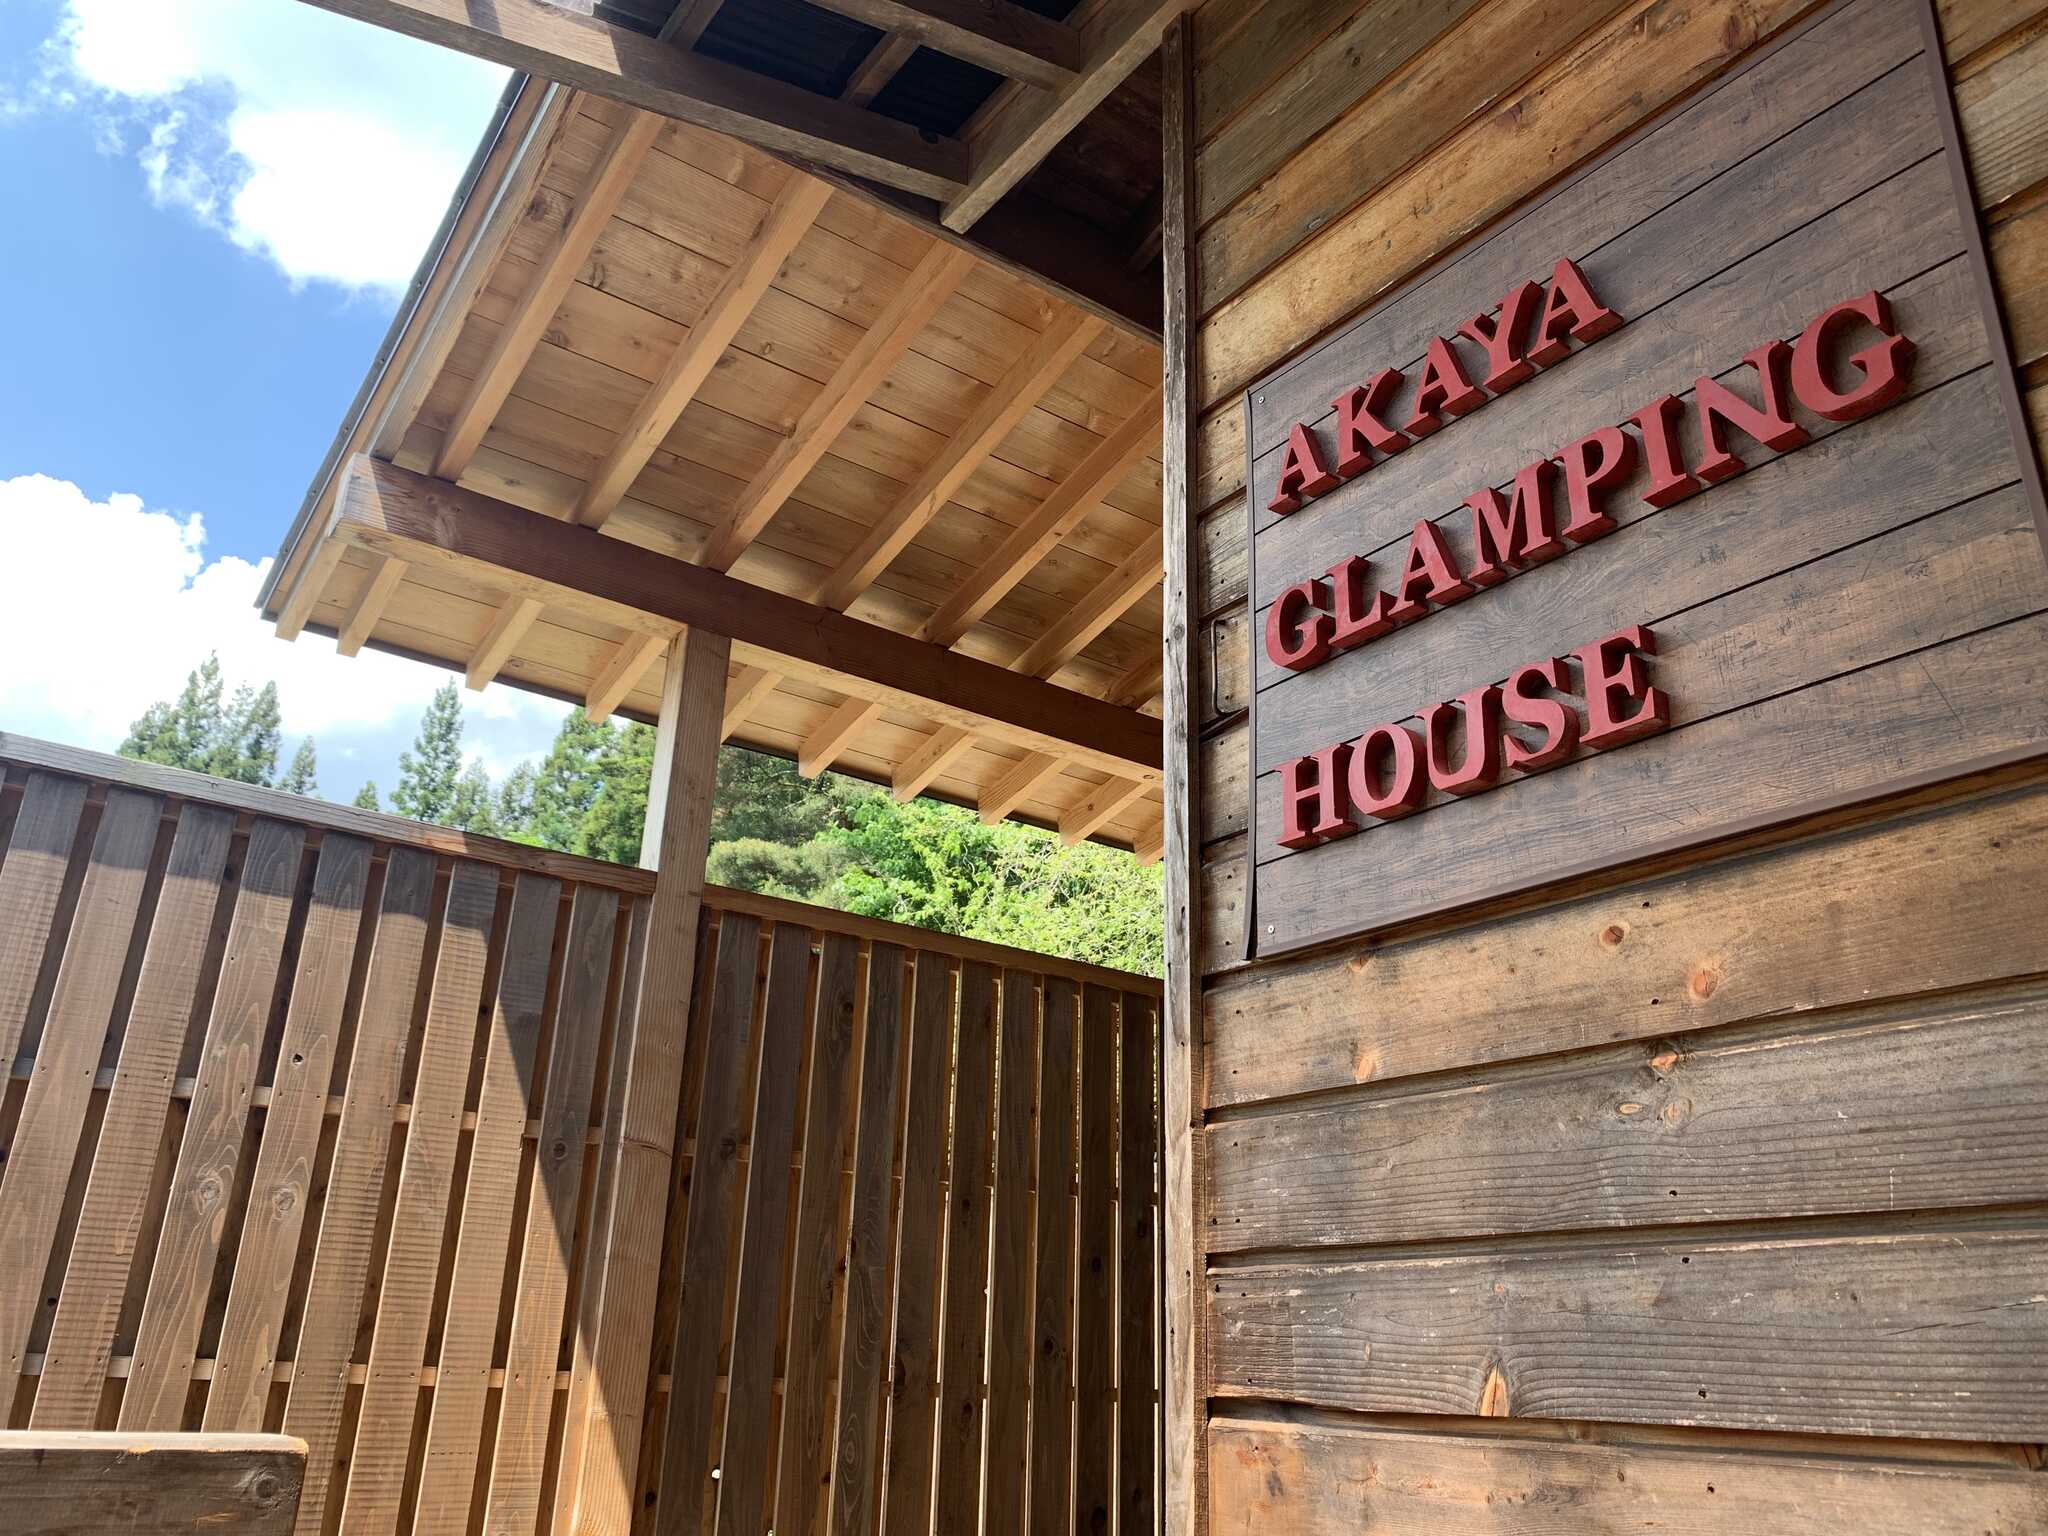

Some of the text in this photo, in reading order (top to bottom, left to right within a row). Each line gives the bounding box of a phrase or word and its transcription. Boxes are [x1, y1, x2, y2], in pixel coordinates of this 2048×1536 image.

[1266, 290, 1915, 671] GLAMPING
[1267, 258, 1623, 514] AKAYA
[1276, 625, 1670, 849] HOUSE
